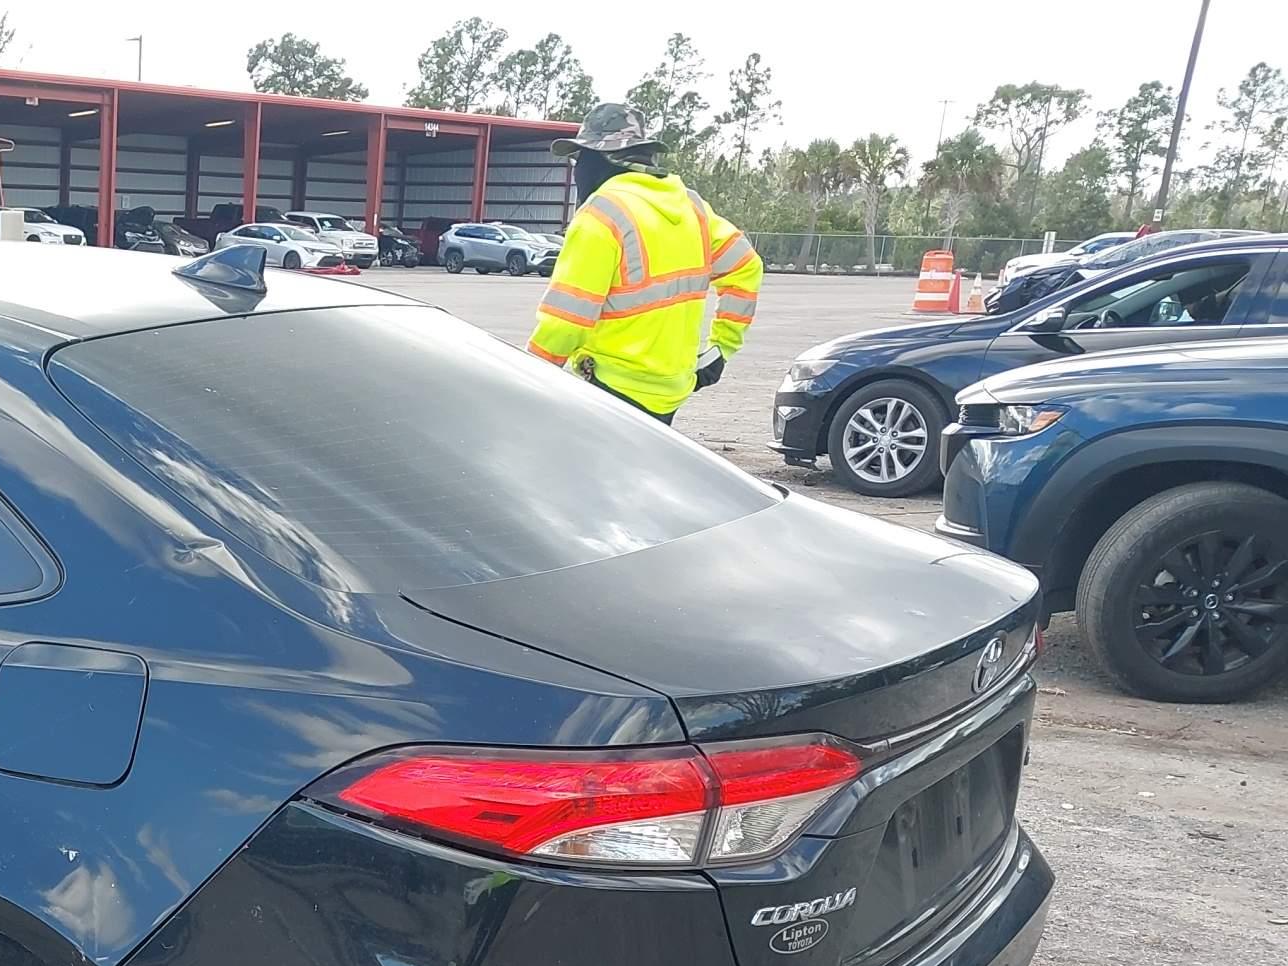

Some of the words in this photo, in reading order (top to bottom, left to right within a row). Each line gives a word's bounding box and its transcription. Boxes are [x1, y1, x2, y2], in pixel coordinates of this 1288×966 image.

[750, 887, 857, 927] COROLLA
[782, 922, 822, 942] Lipton
[787, 937, 813, 952] TOYOTA
